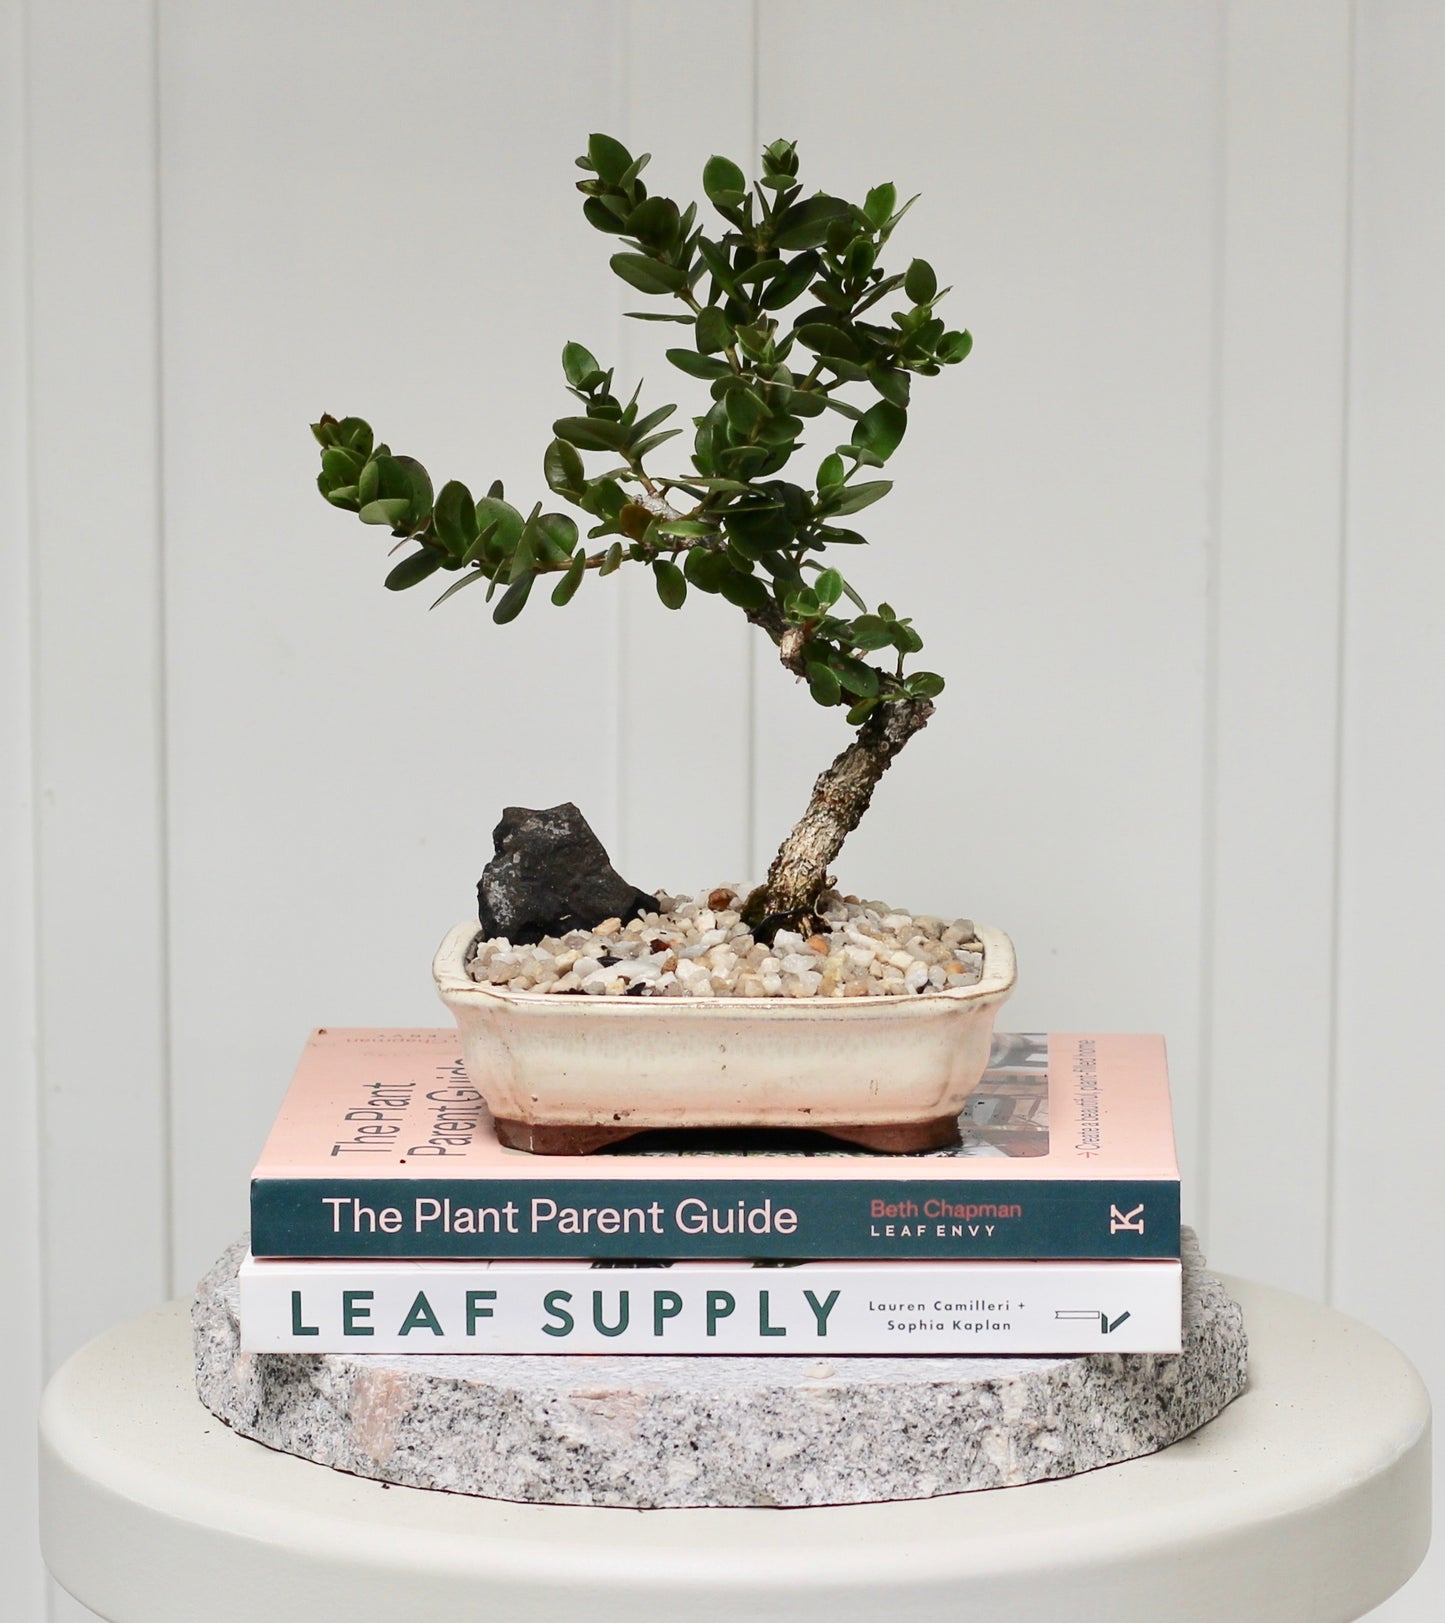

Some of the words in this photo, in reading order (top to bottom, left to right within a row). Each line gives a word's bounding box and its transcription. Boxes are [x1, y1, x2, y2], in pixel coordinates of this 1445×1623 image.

[345, 1081, 417, 1121] Plant
[330, 1126, 401, 1157] The
[407, 1104, 483, 1156] Parent
[1075, 1128, 1100, 1150] Create
[321, 1197, 403, 1234] The
[415, 1197, 520, 1234] Plant
[531, 1197, 665, 1234] Parent
[675, 1197, 798, 1234] Guide
[870, 1199, 919, 1218] Beth
[923, 1199, 1022, 1221] Chapman
[1109, 1203, 1145, 1236] K
[870, 1224, 927, 1237] LEAF
[936, 1224, 996, 1237] ENVY
[291, 1290, 498, 1337] LEAF
[541, 1289, 841, 1338] SUPPLY
[869, 1300, 926, 1312] Lauren
[933, 1299, 1010, 1312] Camilleri
[887, 1319, 944, 1334] Sophia
[952, 1319, 1012, 1334] Kaplan
